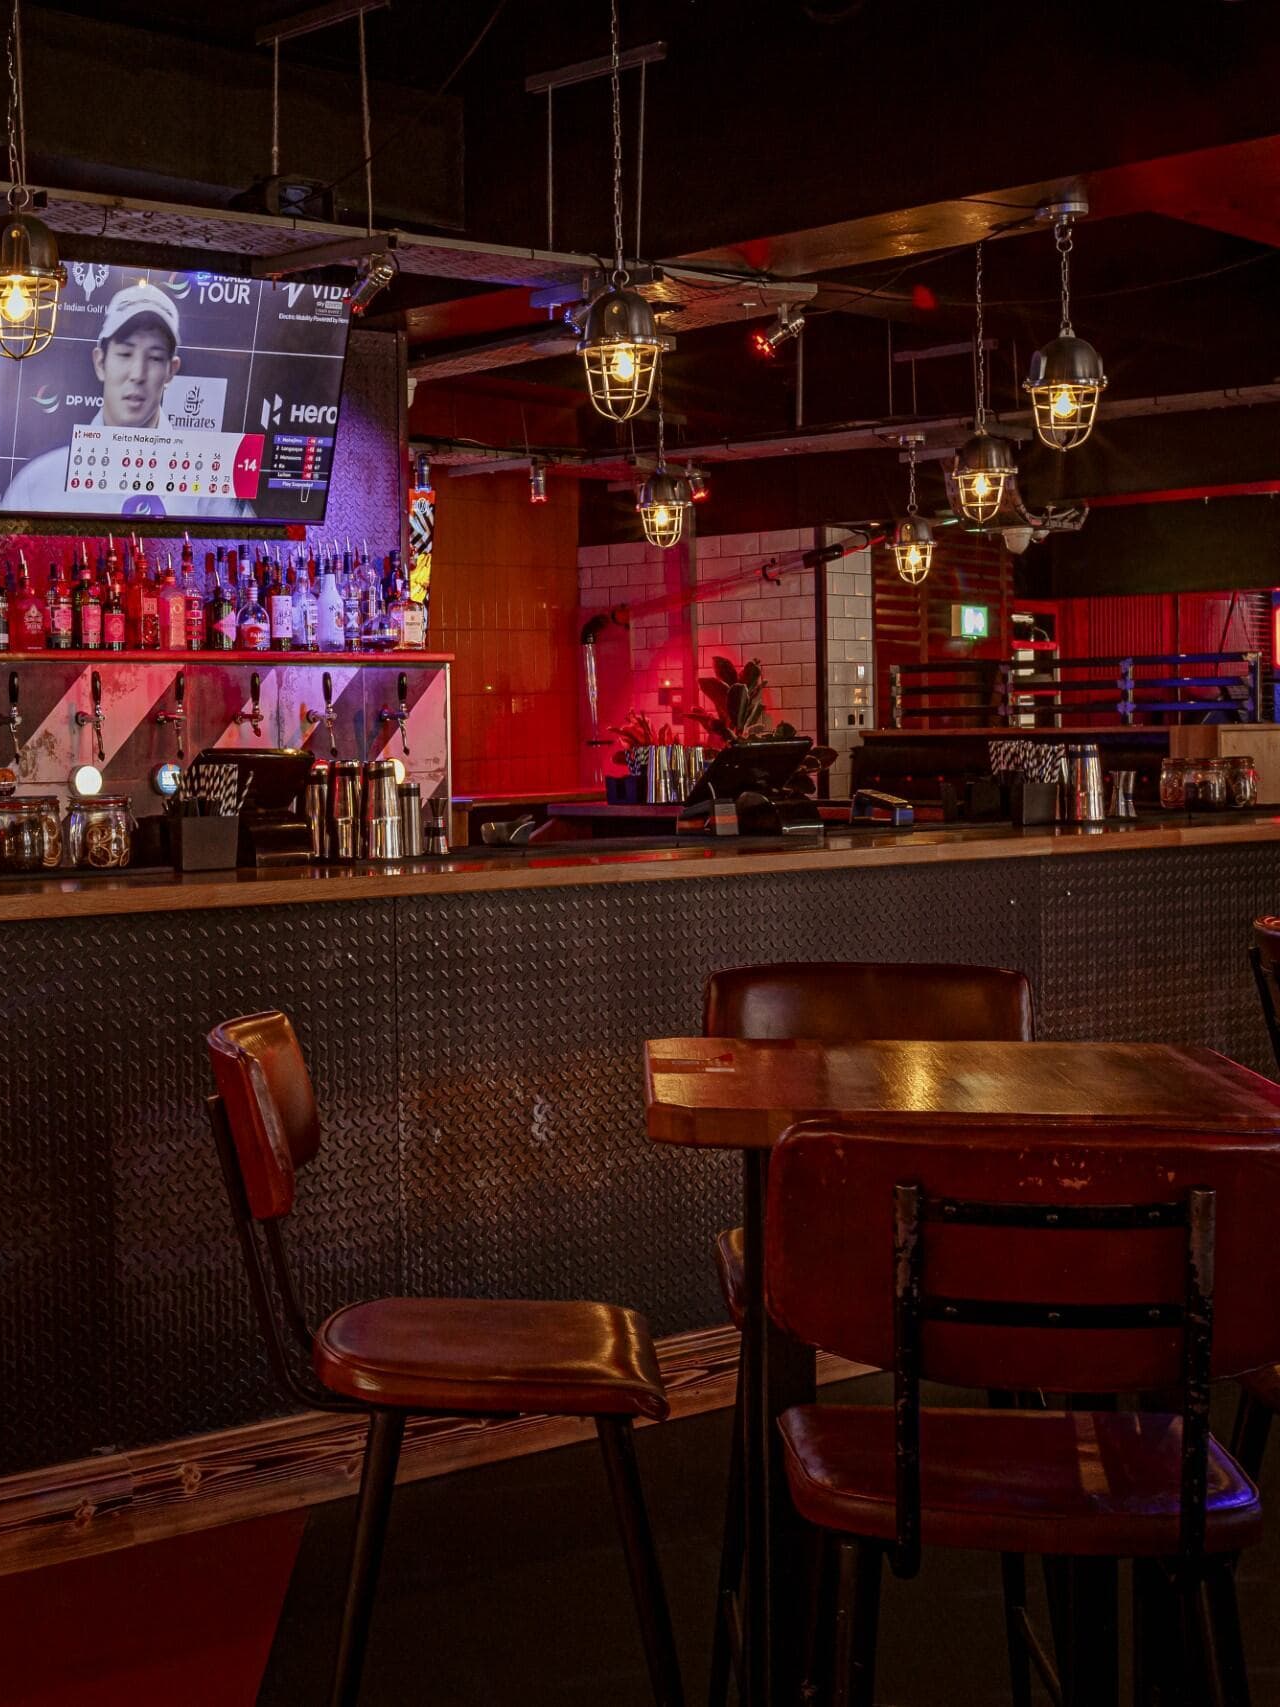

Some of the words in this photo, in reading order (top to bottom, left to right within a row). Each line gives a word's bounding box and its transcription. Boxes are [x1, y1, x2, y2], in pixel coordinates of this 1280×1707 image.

[197, 281, 250, 305] TOUR
[65, 395, 83, 405] DP
[167, 414, 216, 429] Emirates
[133, 434, 171, 446] Nakajima
[237, 458, 257, 472] -14
